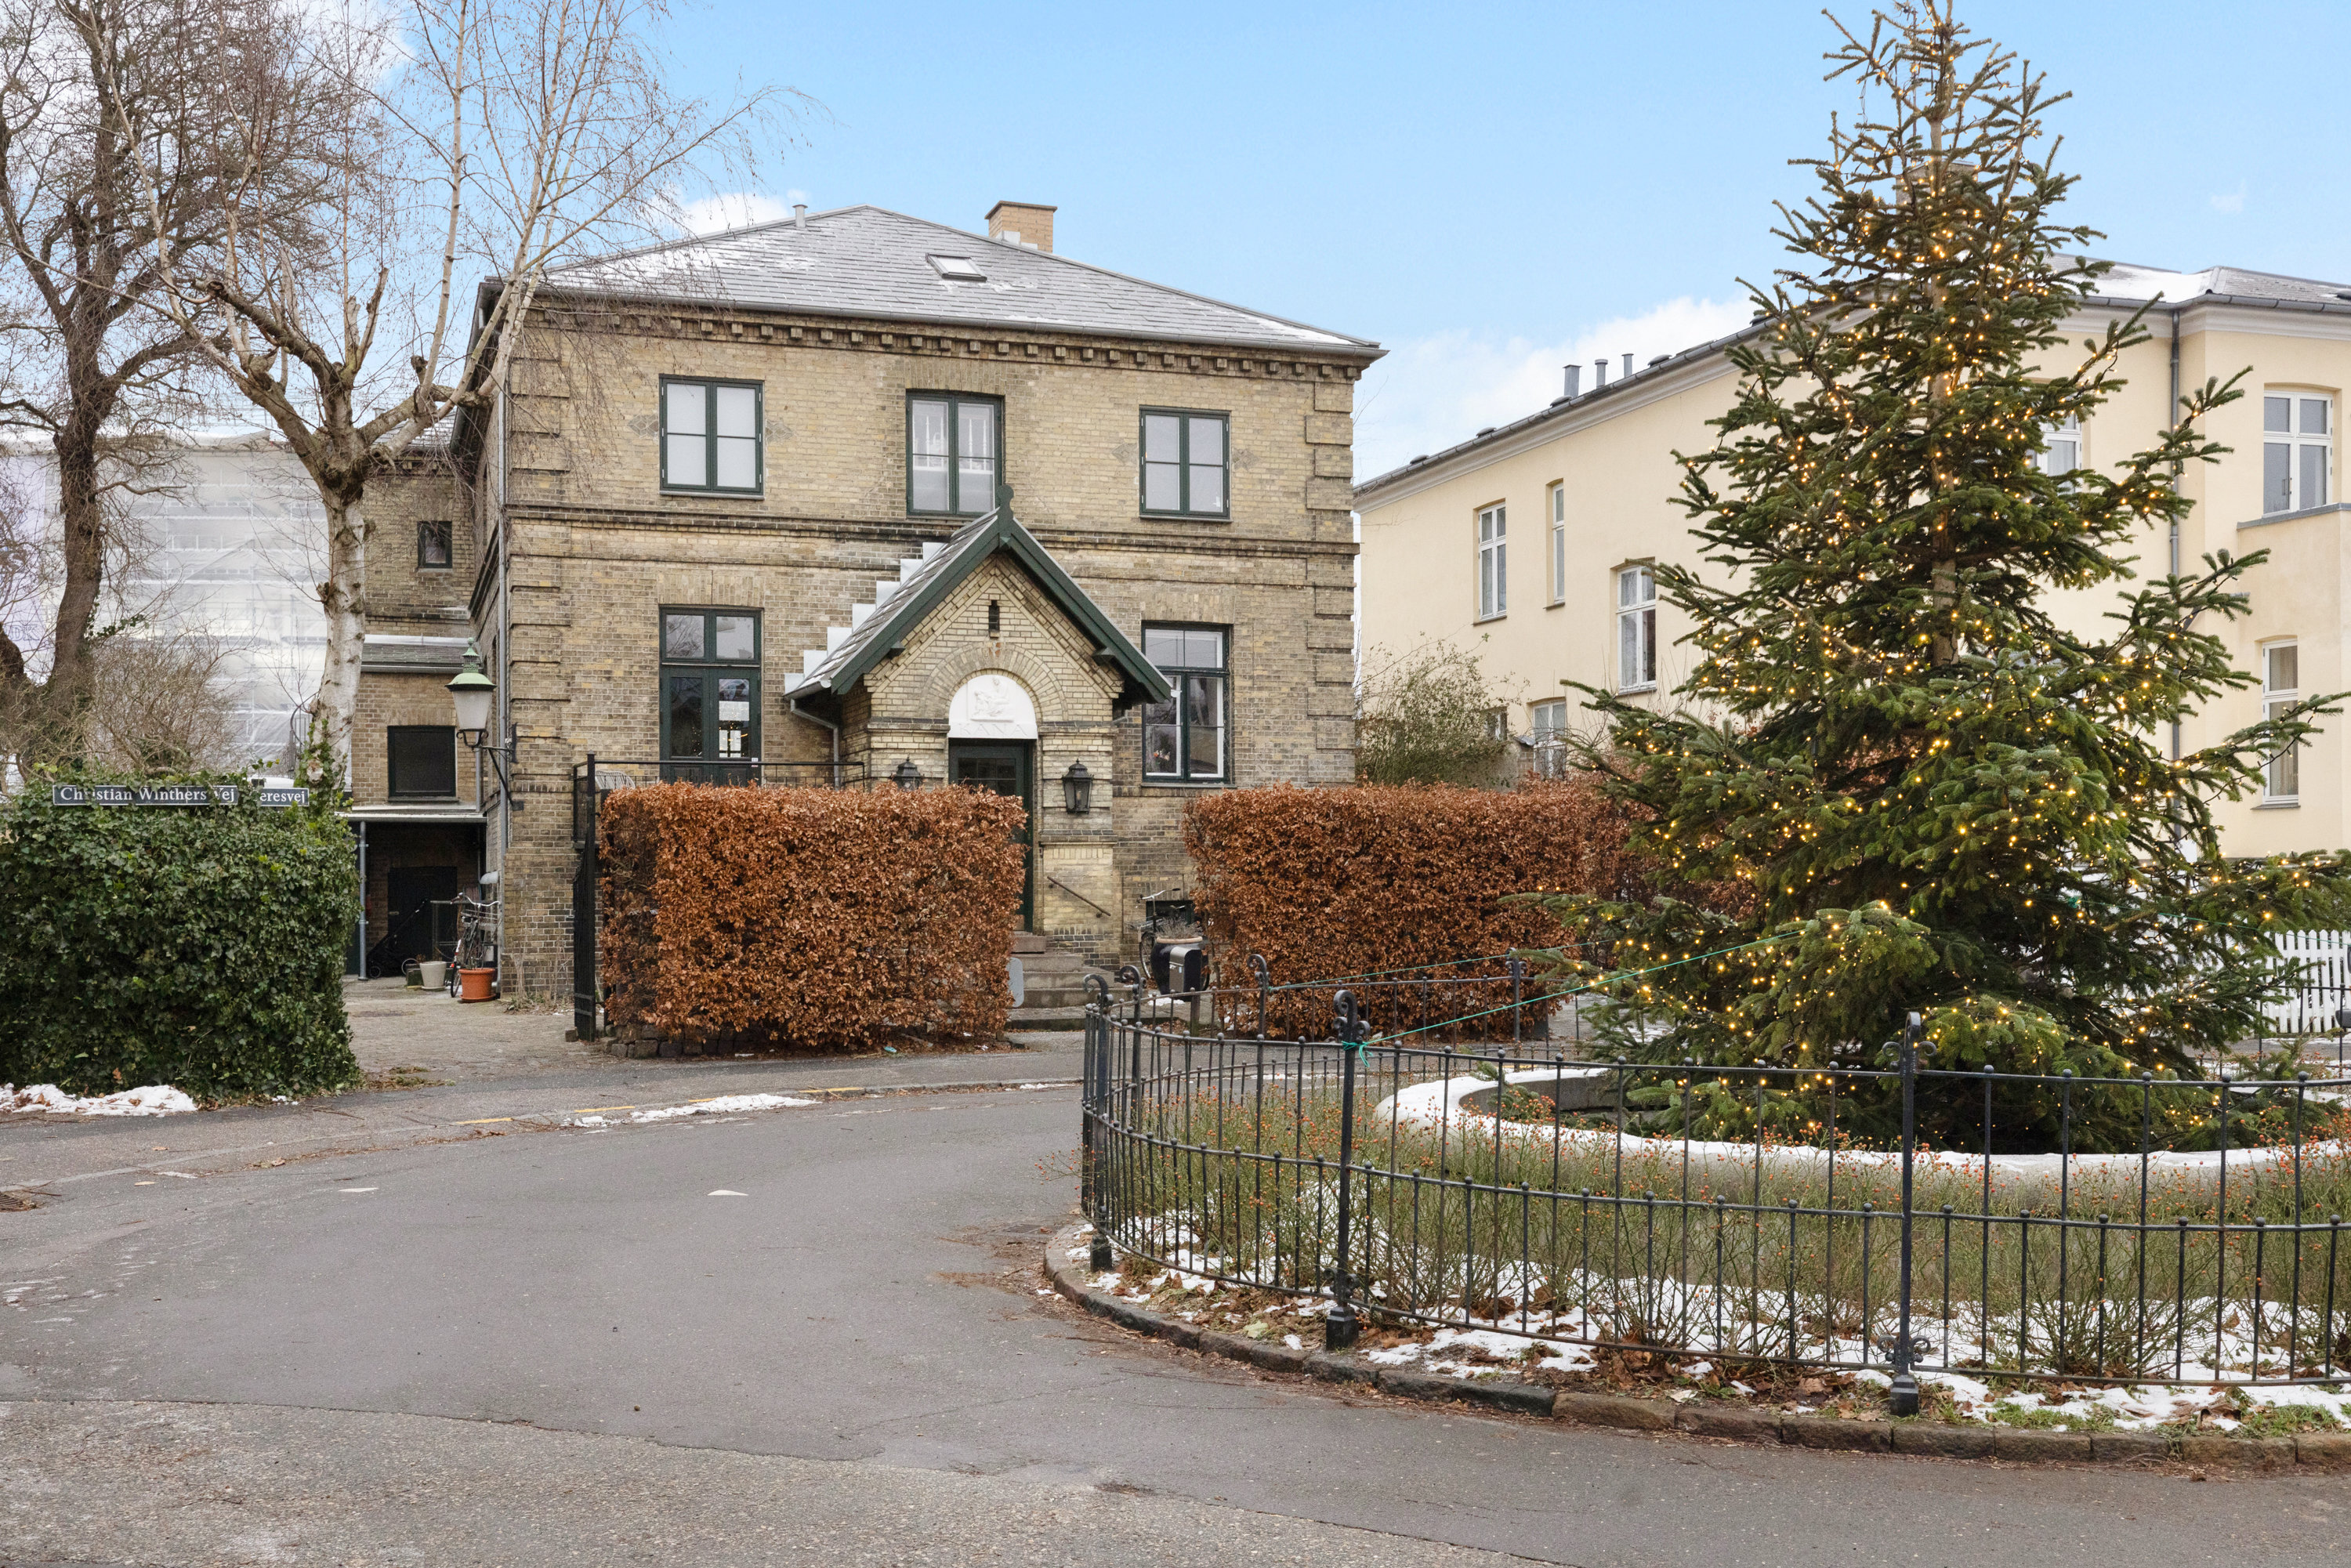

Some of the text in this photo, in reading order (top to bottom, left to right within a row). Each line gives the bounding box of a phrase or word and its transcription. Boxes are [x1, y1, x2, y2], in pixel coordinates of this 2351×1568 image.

[958, 723, 1028, 737] KANA
[60, 787, 234, 803] Chstian Winthers Vej
[259, 790, 305, 804] eresvej
